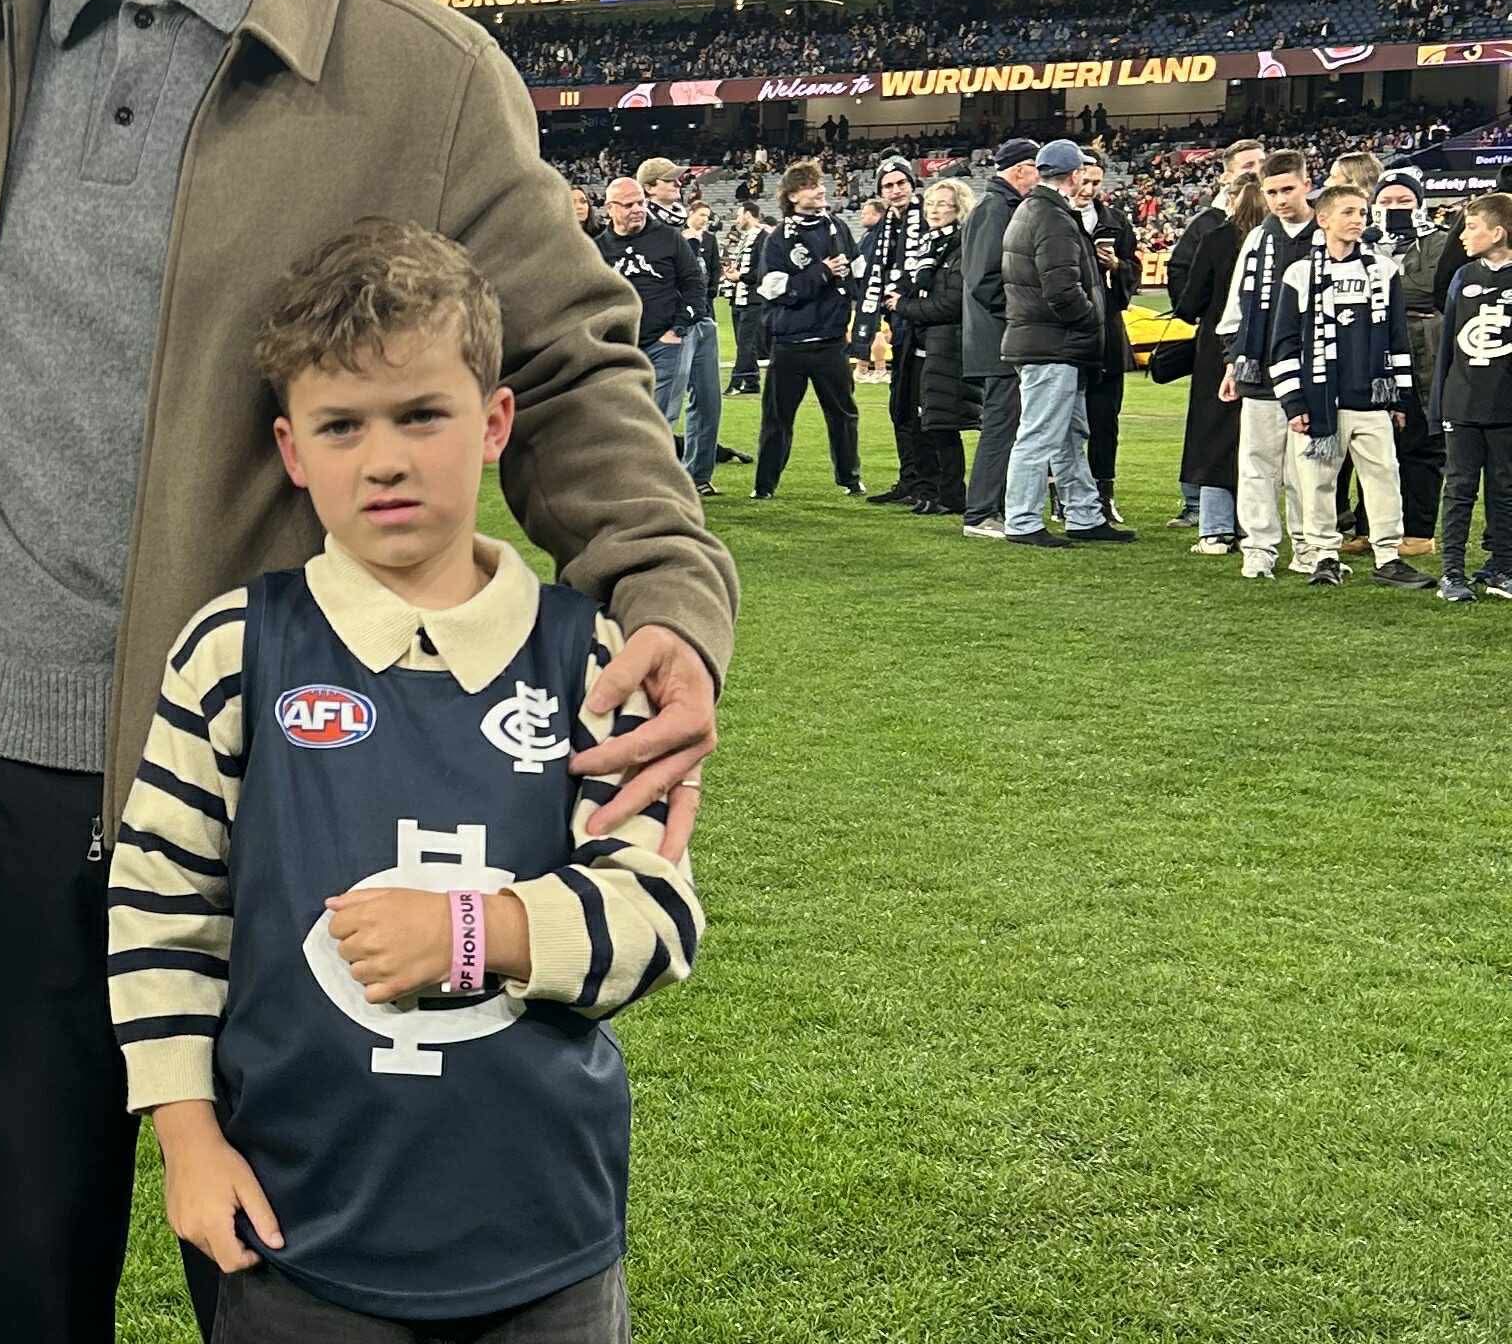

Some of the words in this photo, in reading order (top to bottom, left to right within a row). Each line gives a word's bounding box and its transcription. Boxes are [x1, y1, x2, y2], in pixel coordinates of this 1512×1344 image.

[757, 78, 847, 102] Welcome
[850, 73, 875, 96] to
[881, 60, 1113, 98] WURUNDJERI
[1118, 54, 1216, 87] LAND
[861, 264, 882, 313] CLUB
[283, 699, 369, 732] AFL
[459, 893, 476, 967] HONOUR
[459, 970, 474, 991] OF
